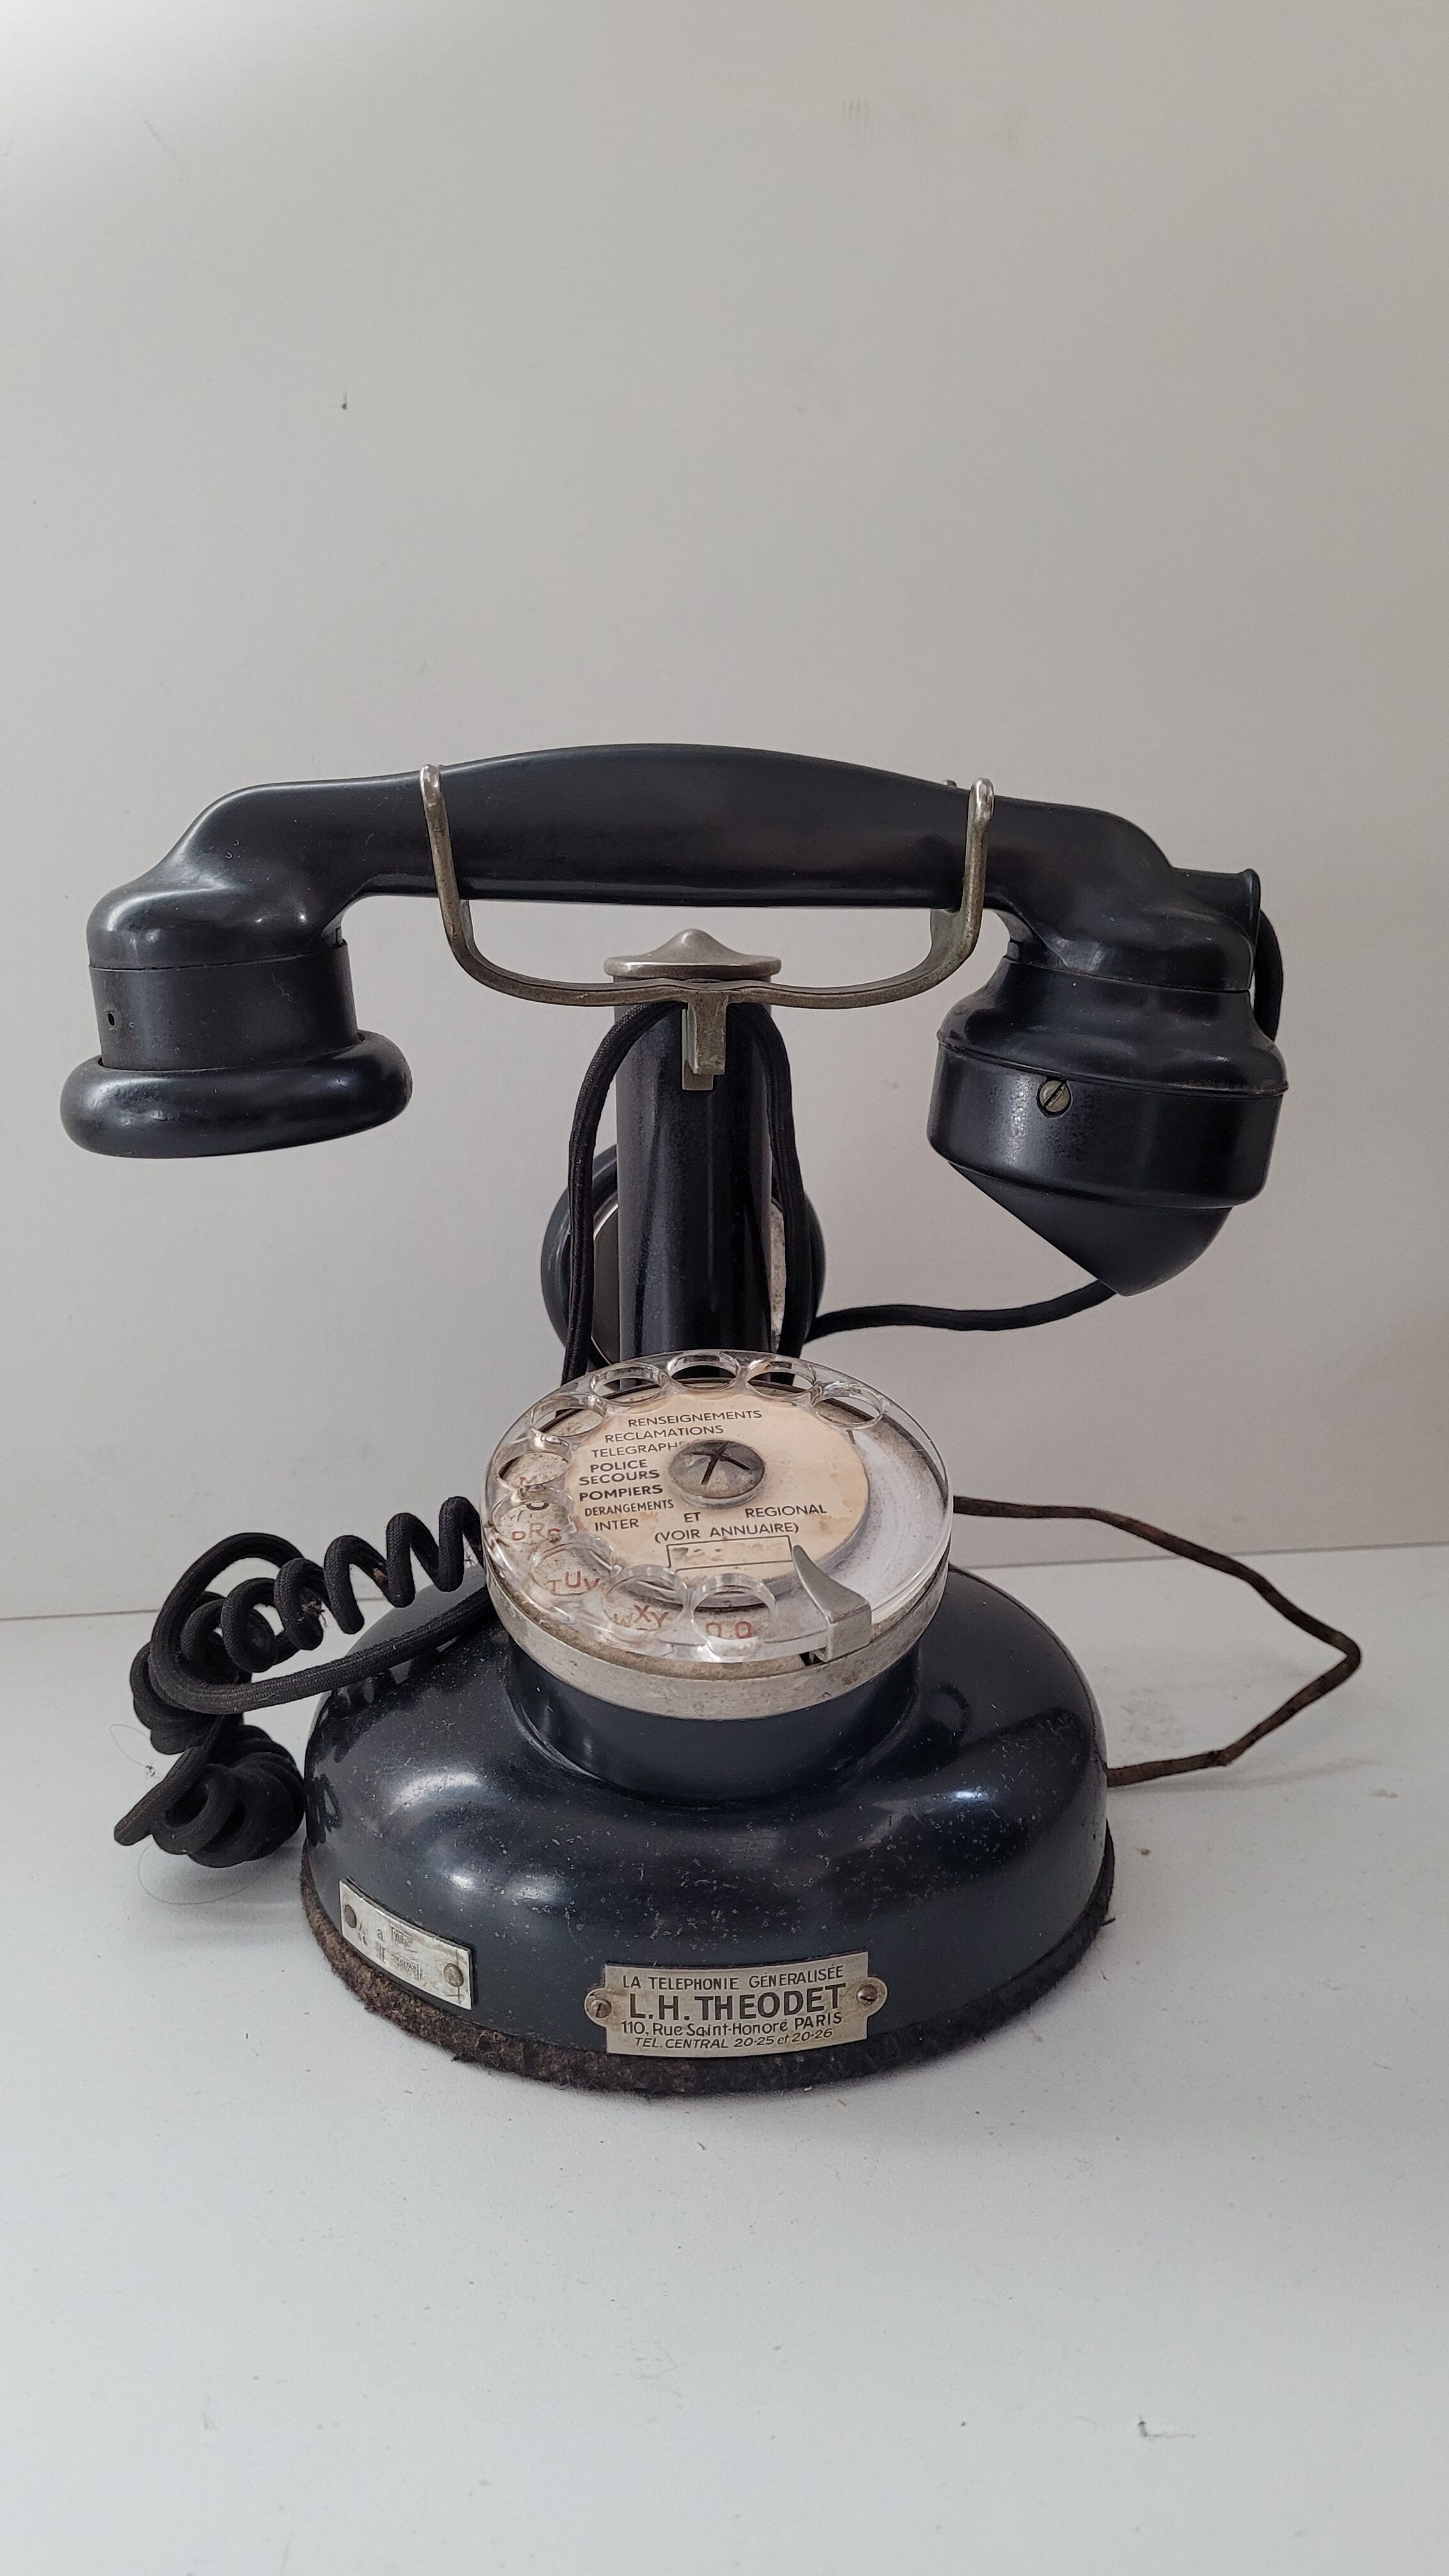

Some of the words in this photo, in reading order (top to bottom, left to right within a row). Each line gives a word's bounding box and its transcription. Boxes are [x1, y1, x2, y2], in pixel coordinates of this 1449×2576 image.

[628, 1410, 762, 1427] RENSEIGNEMENTS
[604, 1425, 724, 1443] RECLAMATIONS
[591, 1441, 691, 1458] TELEGRAPH
[590, 1459, 648, 1473] POLICE
[579, 1469, 660, 1486] SECOURS
[579, 1484, 663, 1502] POMPIERS
[585, 1499, 674, 1517] DERANGEMENTS
[595, 1518, 639, 1531] INTER
[684, 1512, 701, 1523] ET
[745, 1504, 827, 1519] REGIONAL
[654, 1529, 701, 1544] (VOIR
[710, 1522, 799, 1538] ANNUAIRE)
[623, 1975, 641, 1989] LA
[648, 1976, 739, 1991] TELEPHONIE
[694, 1982, 847, 2021] THEODET
[622, 2020, 650, 2036] 110,
[653, 2022, 683, 2036] Rue
[795, 2011, 842, 2030] PARIS
[634, 2037, 663, 2048] TEL.
[665, 2038, 729, 2049] CENTRAL
[733, 2035, 774, 2048] 20-25
[777, 2033, 790, 2045] et
[792, 2028, 833, 2043] 20-26
